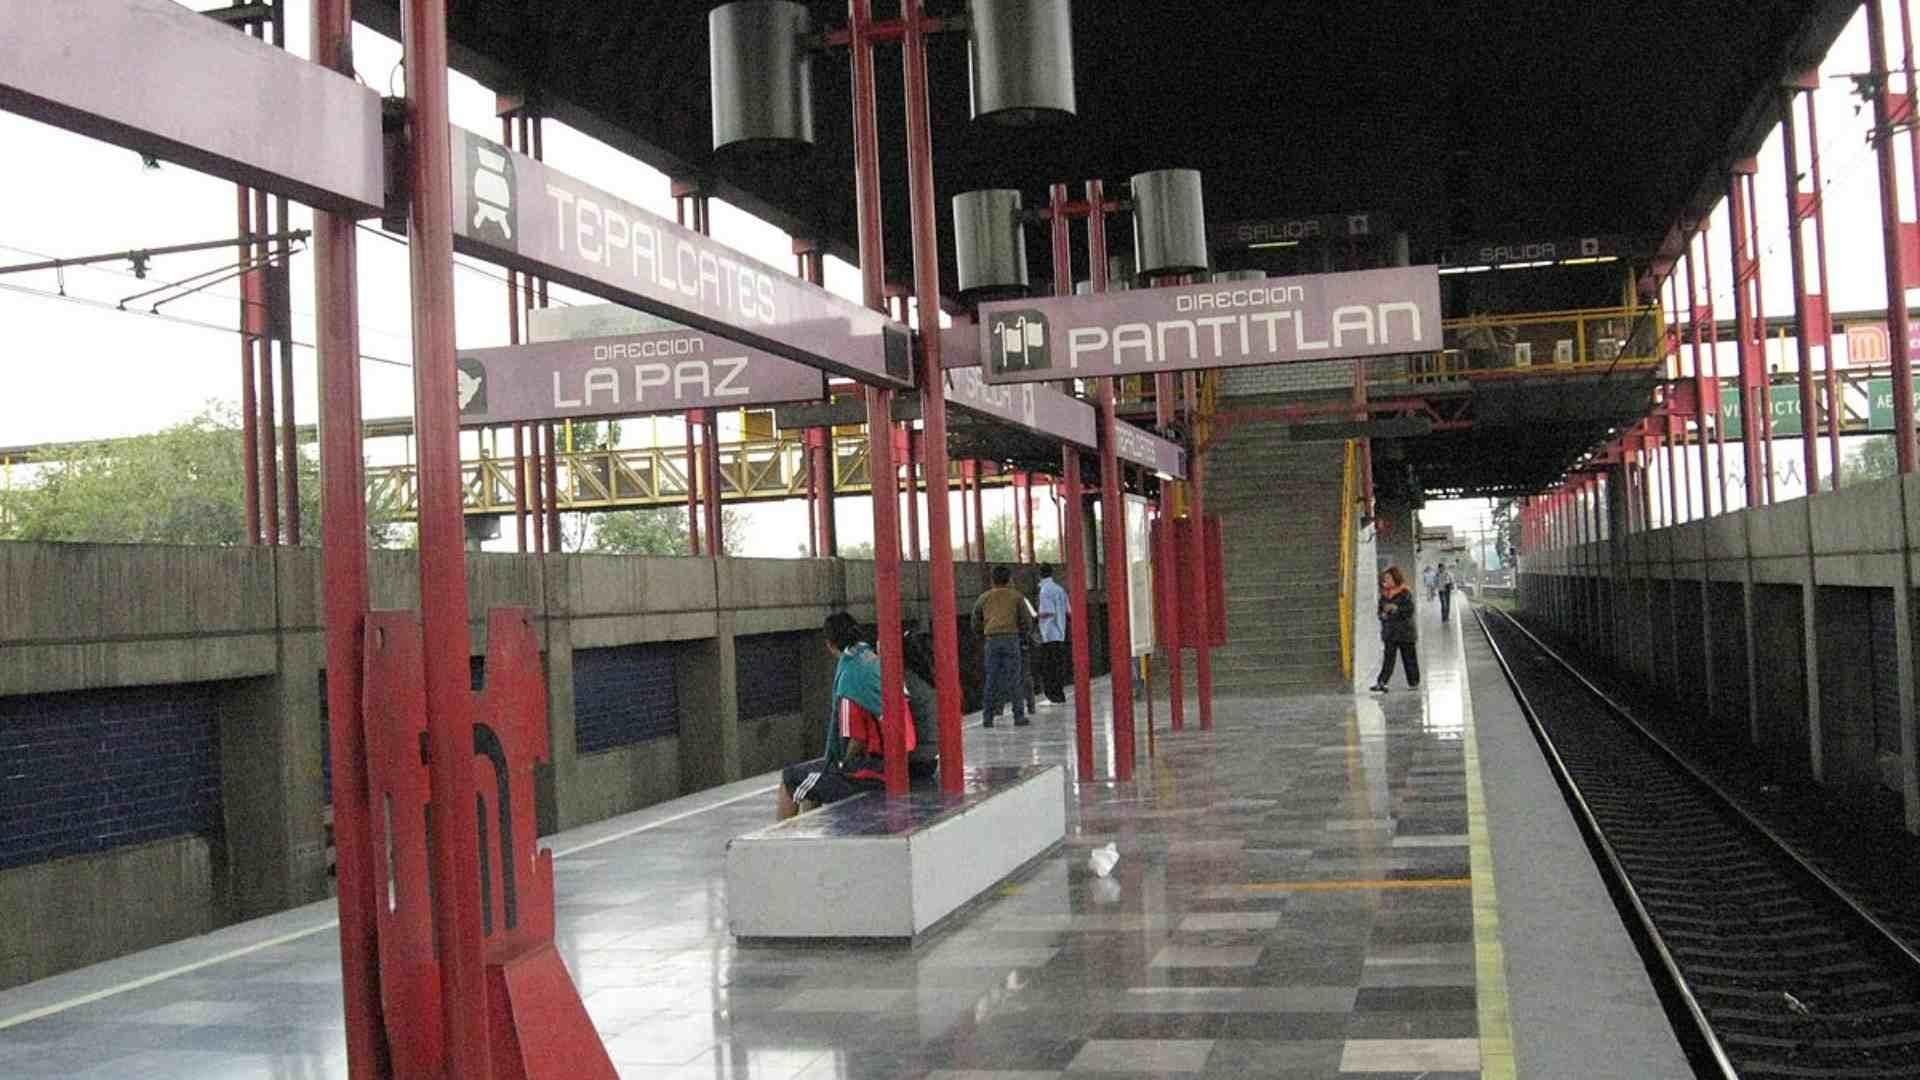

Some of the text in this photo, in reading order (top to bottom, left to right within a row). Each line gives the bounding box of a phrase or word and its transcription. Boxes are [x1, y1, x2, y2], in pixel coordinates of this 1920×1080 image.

[546, 183, 775, 324] TEPALCATES
[1480, 242, 1556, 262] SALIDA
[1176, 285, 1304, 312] DIRECCION
[594, 337, 704, 361] DIRECCION
[1068, 302, 1422, 369] PANTITLAN
[553, 356, 749, 408] LA PAZ
